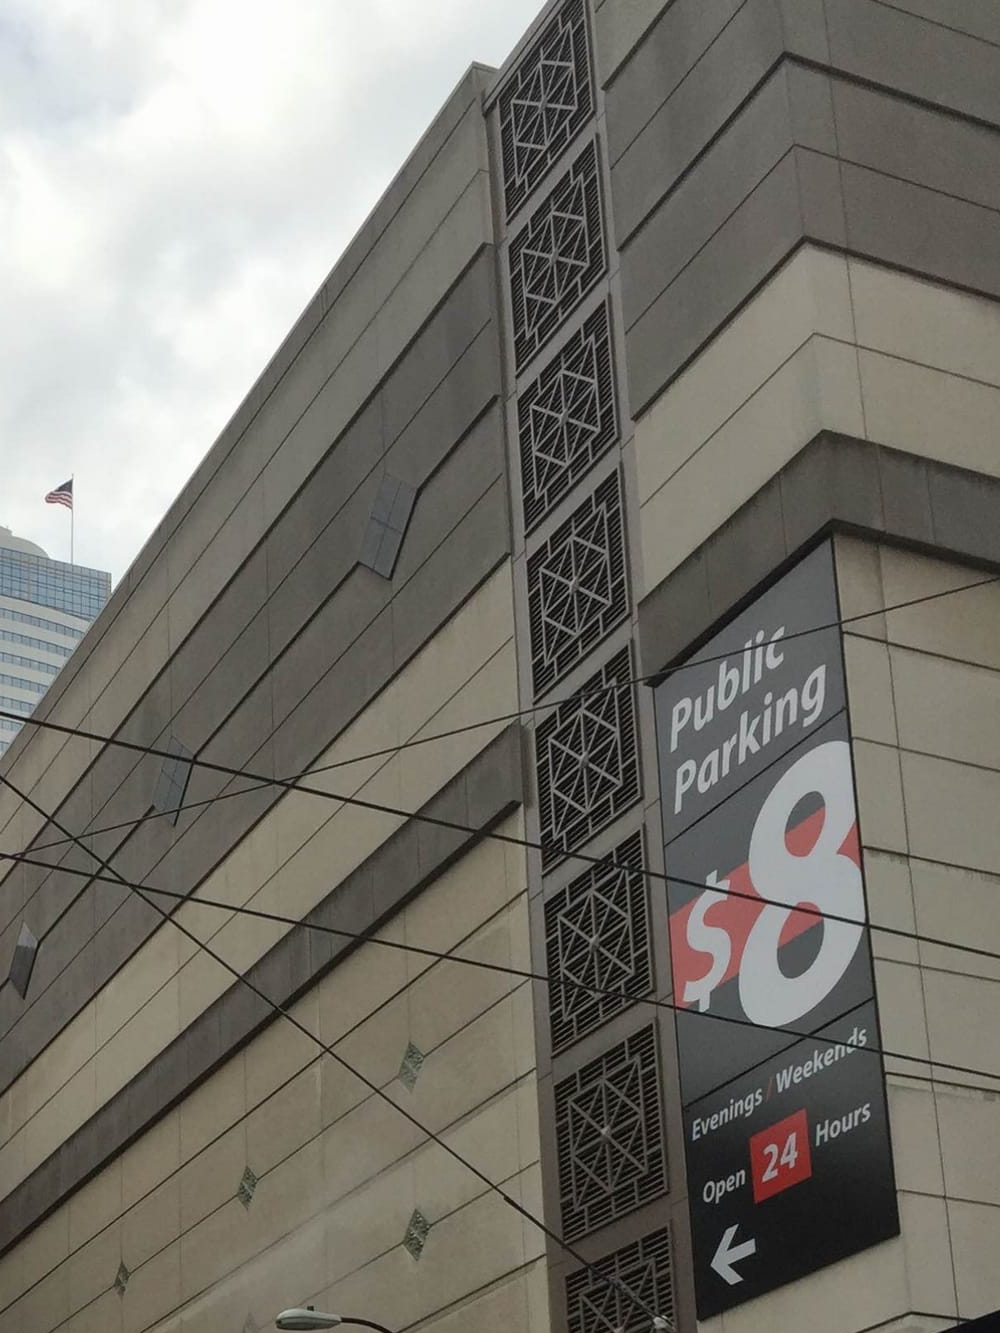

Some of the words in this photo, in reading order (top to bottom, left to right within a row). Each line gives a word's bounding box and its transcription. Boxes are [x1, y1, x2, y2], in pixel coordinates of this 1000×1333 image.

[669, 625, 786, 753] Public
[674, 664, 827, 815] Parking
[691, 1086, 763, 1143] Evenings
[775, 1026, 868, 1094] Weekends
[702, 1168, 746, 1204] Open
[761, 1132, 799, 1183] 24
[815, 1102, 872, 1147] Hours
